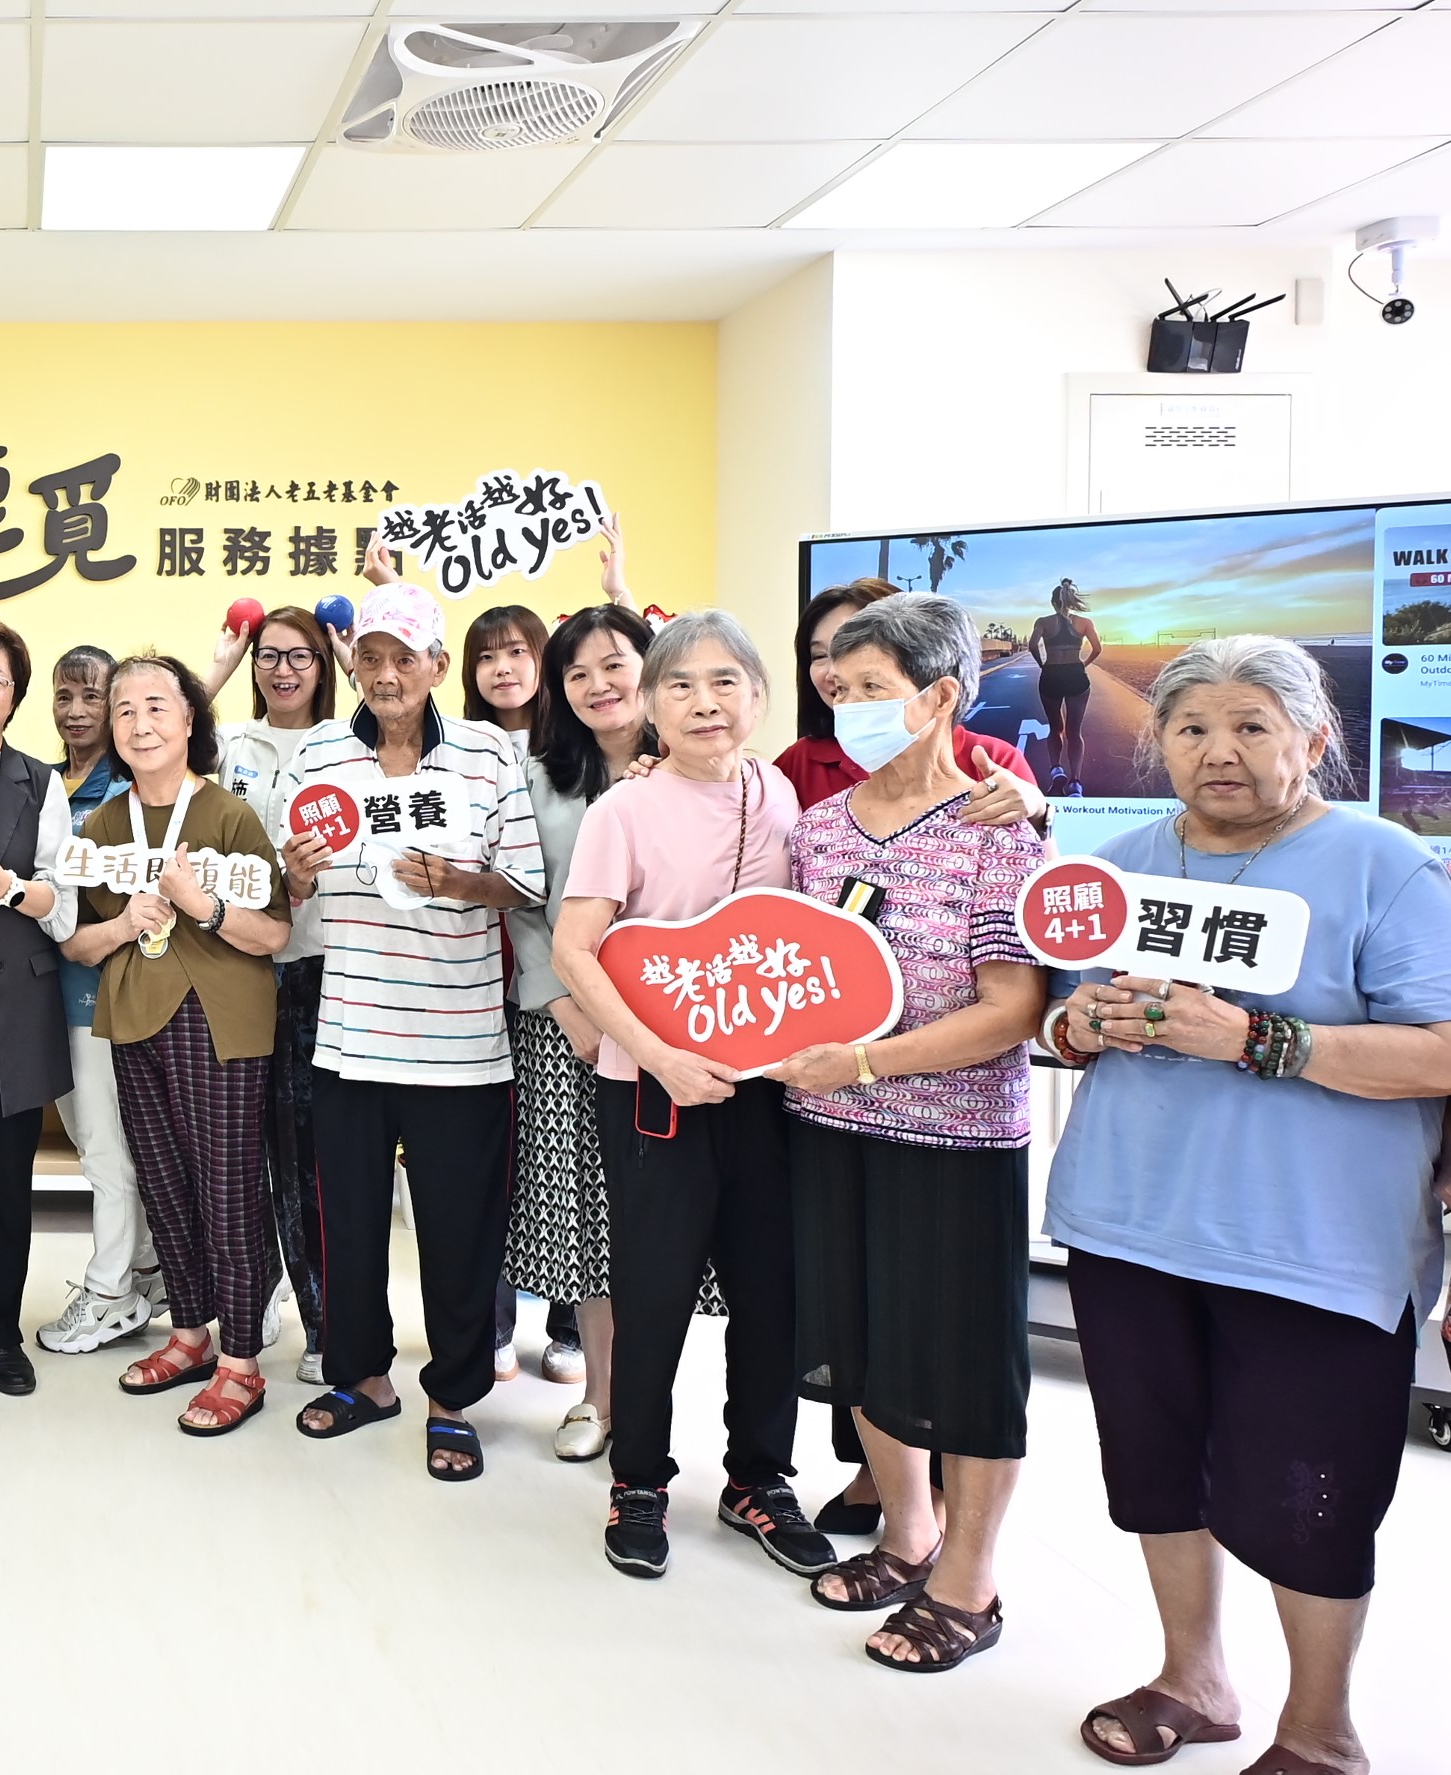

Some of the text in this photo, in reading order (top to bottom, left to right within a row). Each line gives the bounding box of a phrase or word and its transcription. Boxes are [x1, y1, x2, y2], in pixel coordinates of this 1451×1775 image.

[160, 496, 186, 506] OFO
[205, 480, 400, 503] 財團法人老五老基金會
[442, 529, 517, 593] Old
[1393, 549, 1448, 566] WALK
[1430, 574, 1445, 583] 60
[299, 793, 342, 826] 照顧
[364, 790, 447, 835] 營養
[1063, 806, 1105, 814] Workout
[1108, 806, 1163, 815] Motivation
[1042, 882, 1104, 915] 照顧
[1044, 913, 1107, 944] 4+1
[1136, 898, 1268, 968] 習慣
[687, 985, 756, 1042] Old
